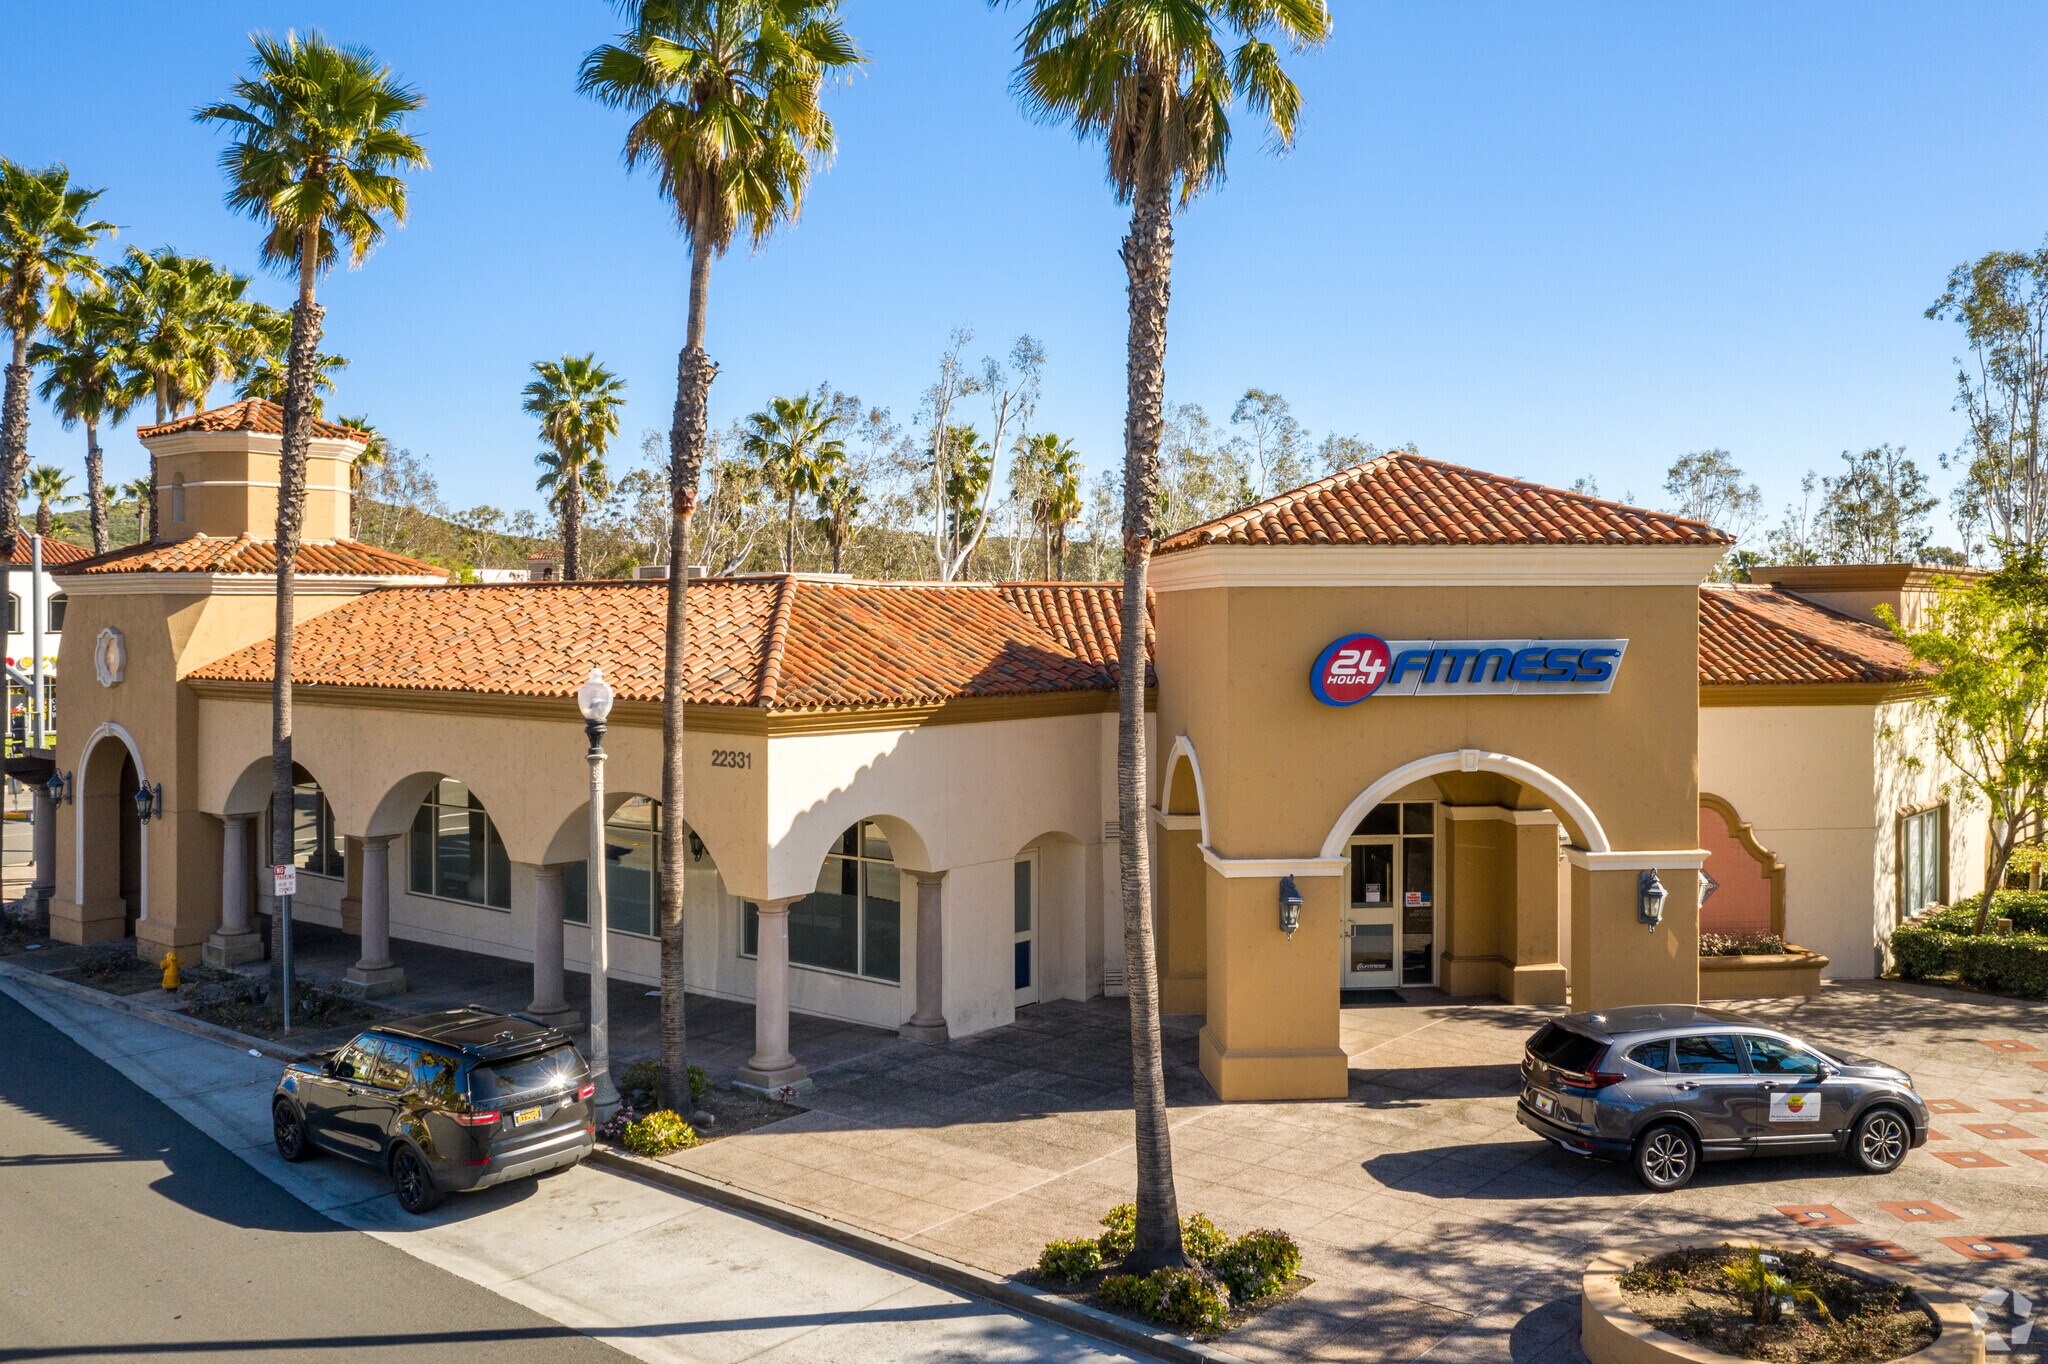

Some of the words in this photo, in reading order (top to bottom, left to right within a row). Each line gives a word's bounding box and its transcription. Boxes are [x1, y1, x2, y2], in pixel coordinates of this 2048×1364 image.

[1331, 649, 1386, 685] 24
[1388, 646, 1619, 684] FITNESS
[1327, 675, 1366, 685] HOUR
[711, 749, 751, 770] 22331
[276, 866, 284, 874] NO
